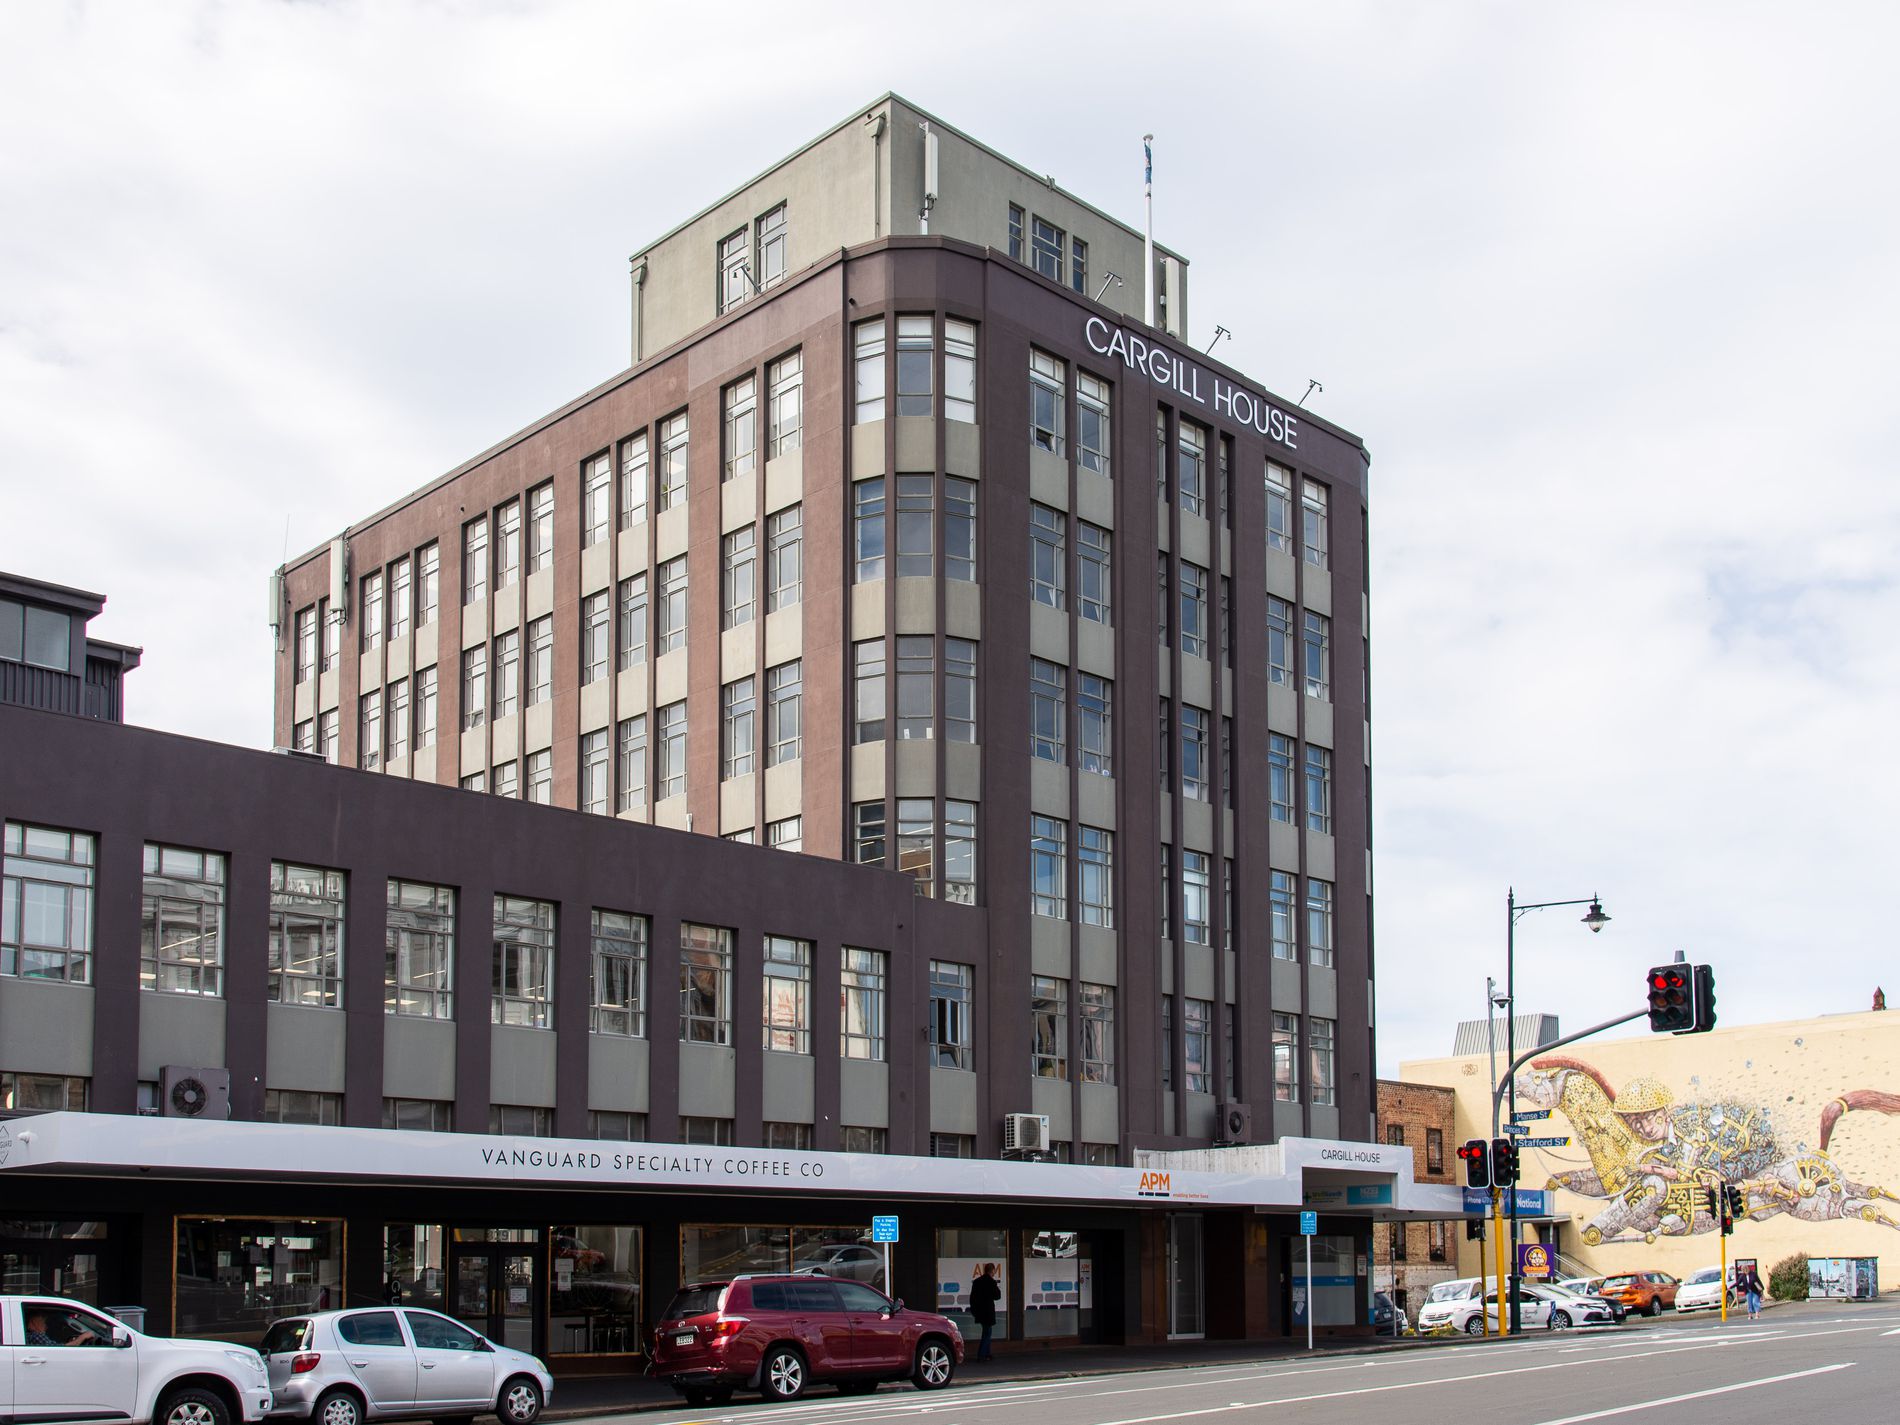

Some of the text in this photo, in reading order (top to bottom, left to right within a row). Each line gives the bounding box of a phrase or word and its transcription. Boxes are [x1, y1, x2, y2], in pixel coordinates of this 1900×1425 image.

[1085, 316, 1298, 450] CARGILL HOUSE
[1539, 1110, 1548, 1118] St
[1521, 1127, 1528, 1135] St
[1518, 1138, 1565, 1147] Stafford St
[481, 1148, 825, 1178] VANGUARD SPECIALTY COFFEE CO
[1321, 1148, 1381, 1164] CARGILL HOUSE
[1139, 1171, 1170, 1191] APM
[1467, 1196, 1481, 1204] Phone
[1516, 1197, 1542, 1209] National
[972, 1263, 1002, 1279] AM
